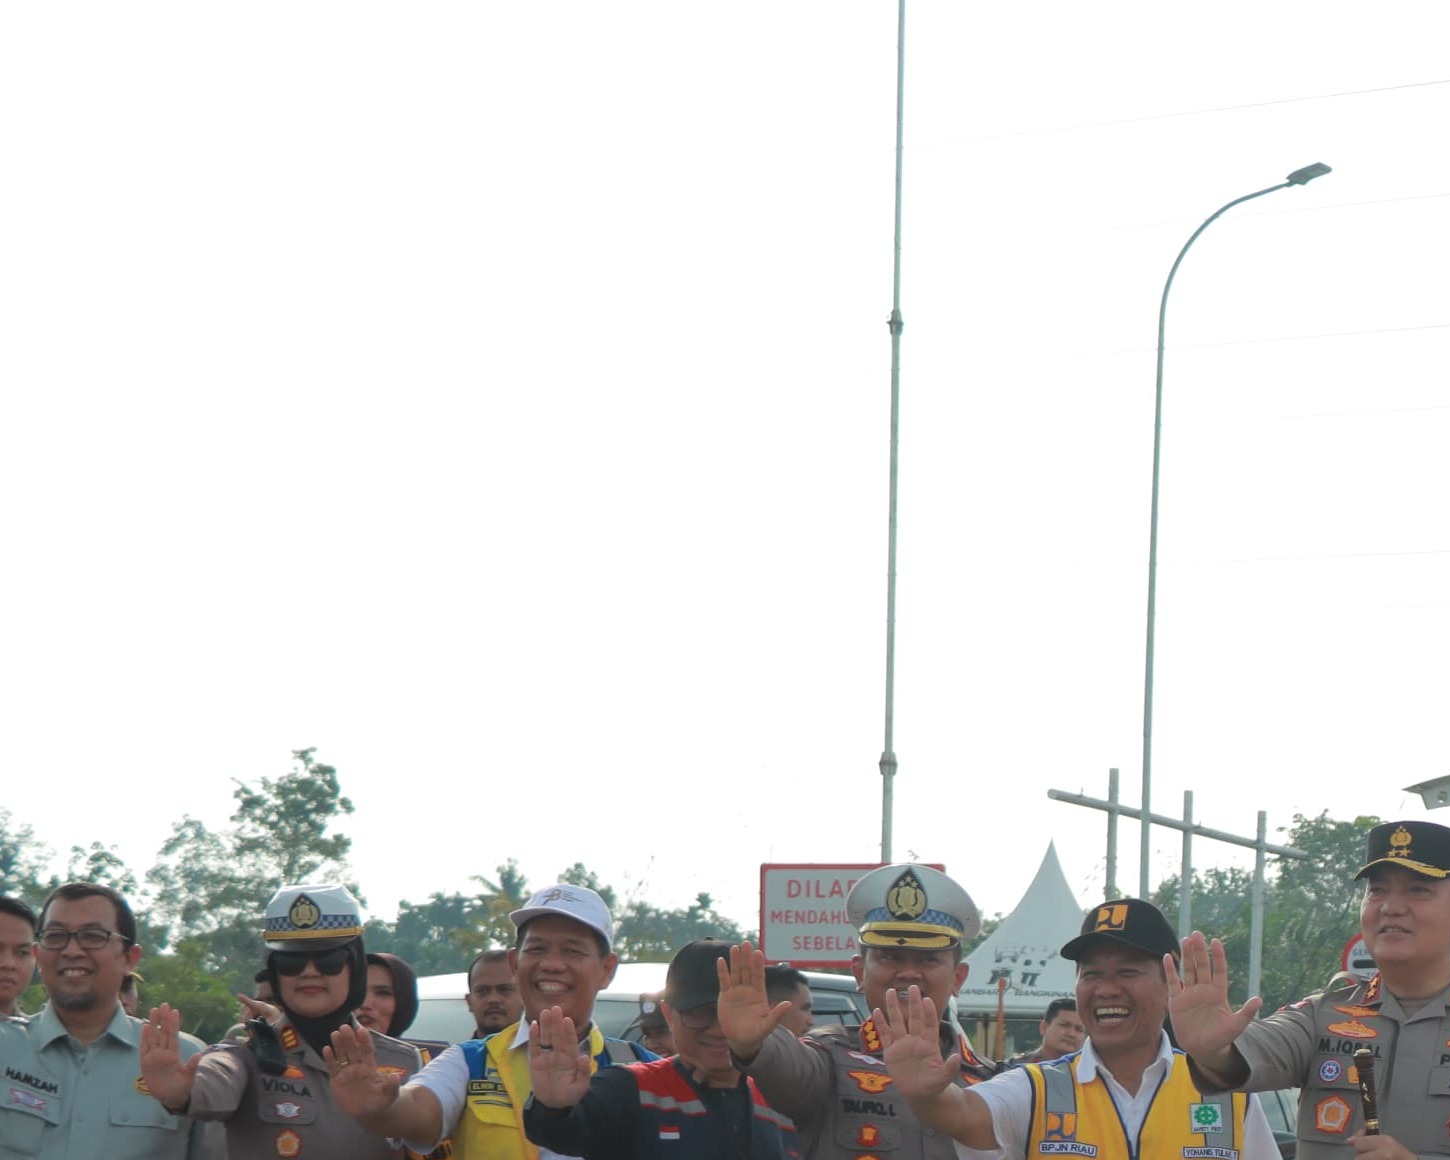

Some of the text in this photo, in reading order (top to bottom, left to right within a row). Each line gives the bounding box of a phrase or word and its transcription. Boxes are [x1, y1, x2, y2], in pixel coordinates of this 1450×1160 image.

[5, 1066, 58, 1094] HAMZAH
[262, 1078, 312, 1098] VIOLA
[1041, 1143, 1095, 1155] BPJN RIAU
